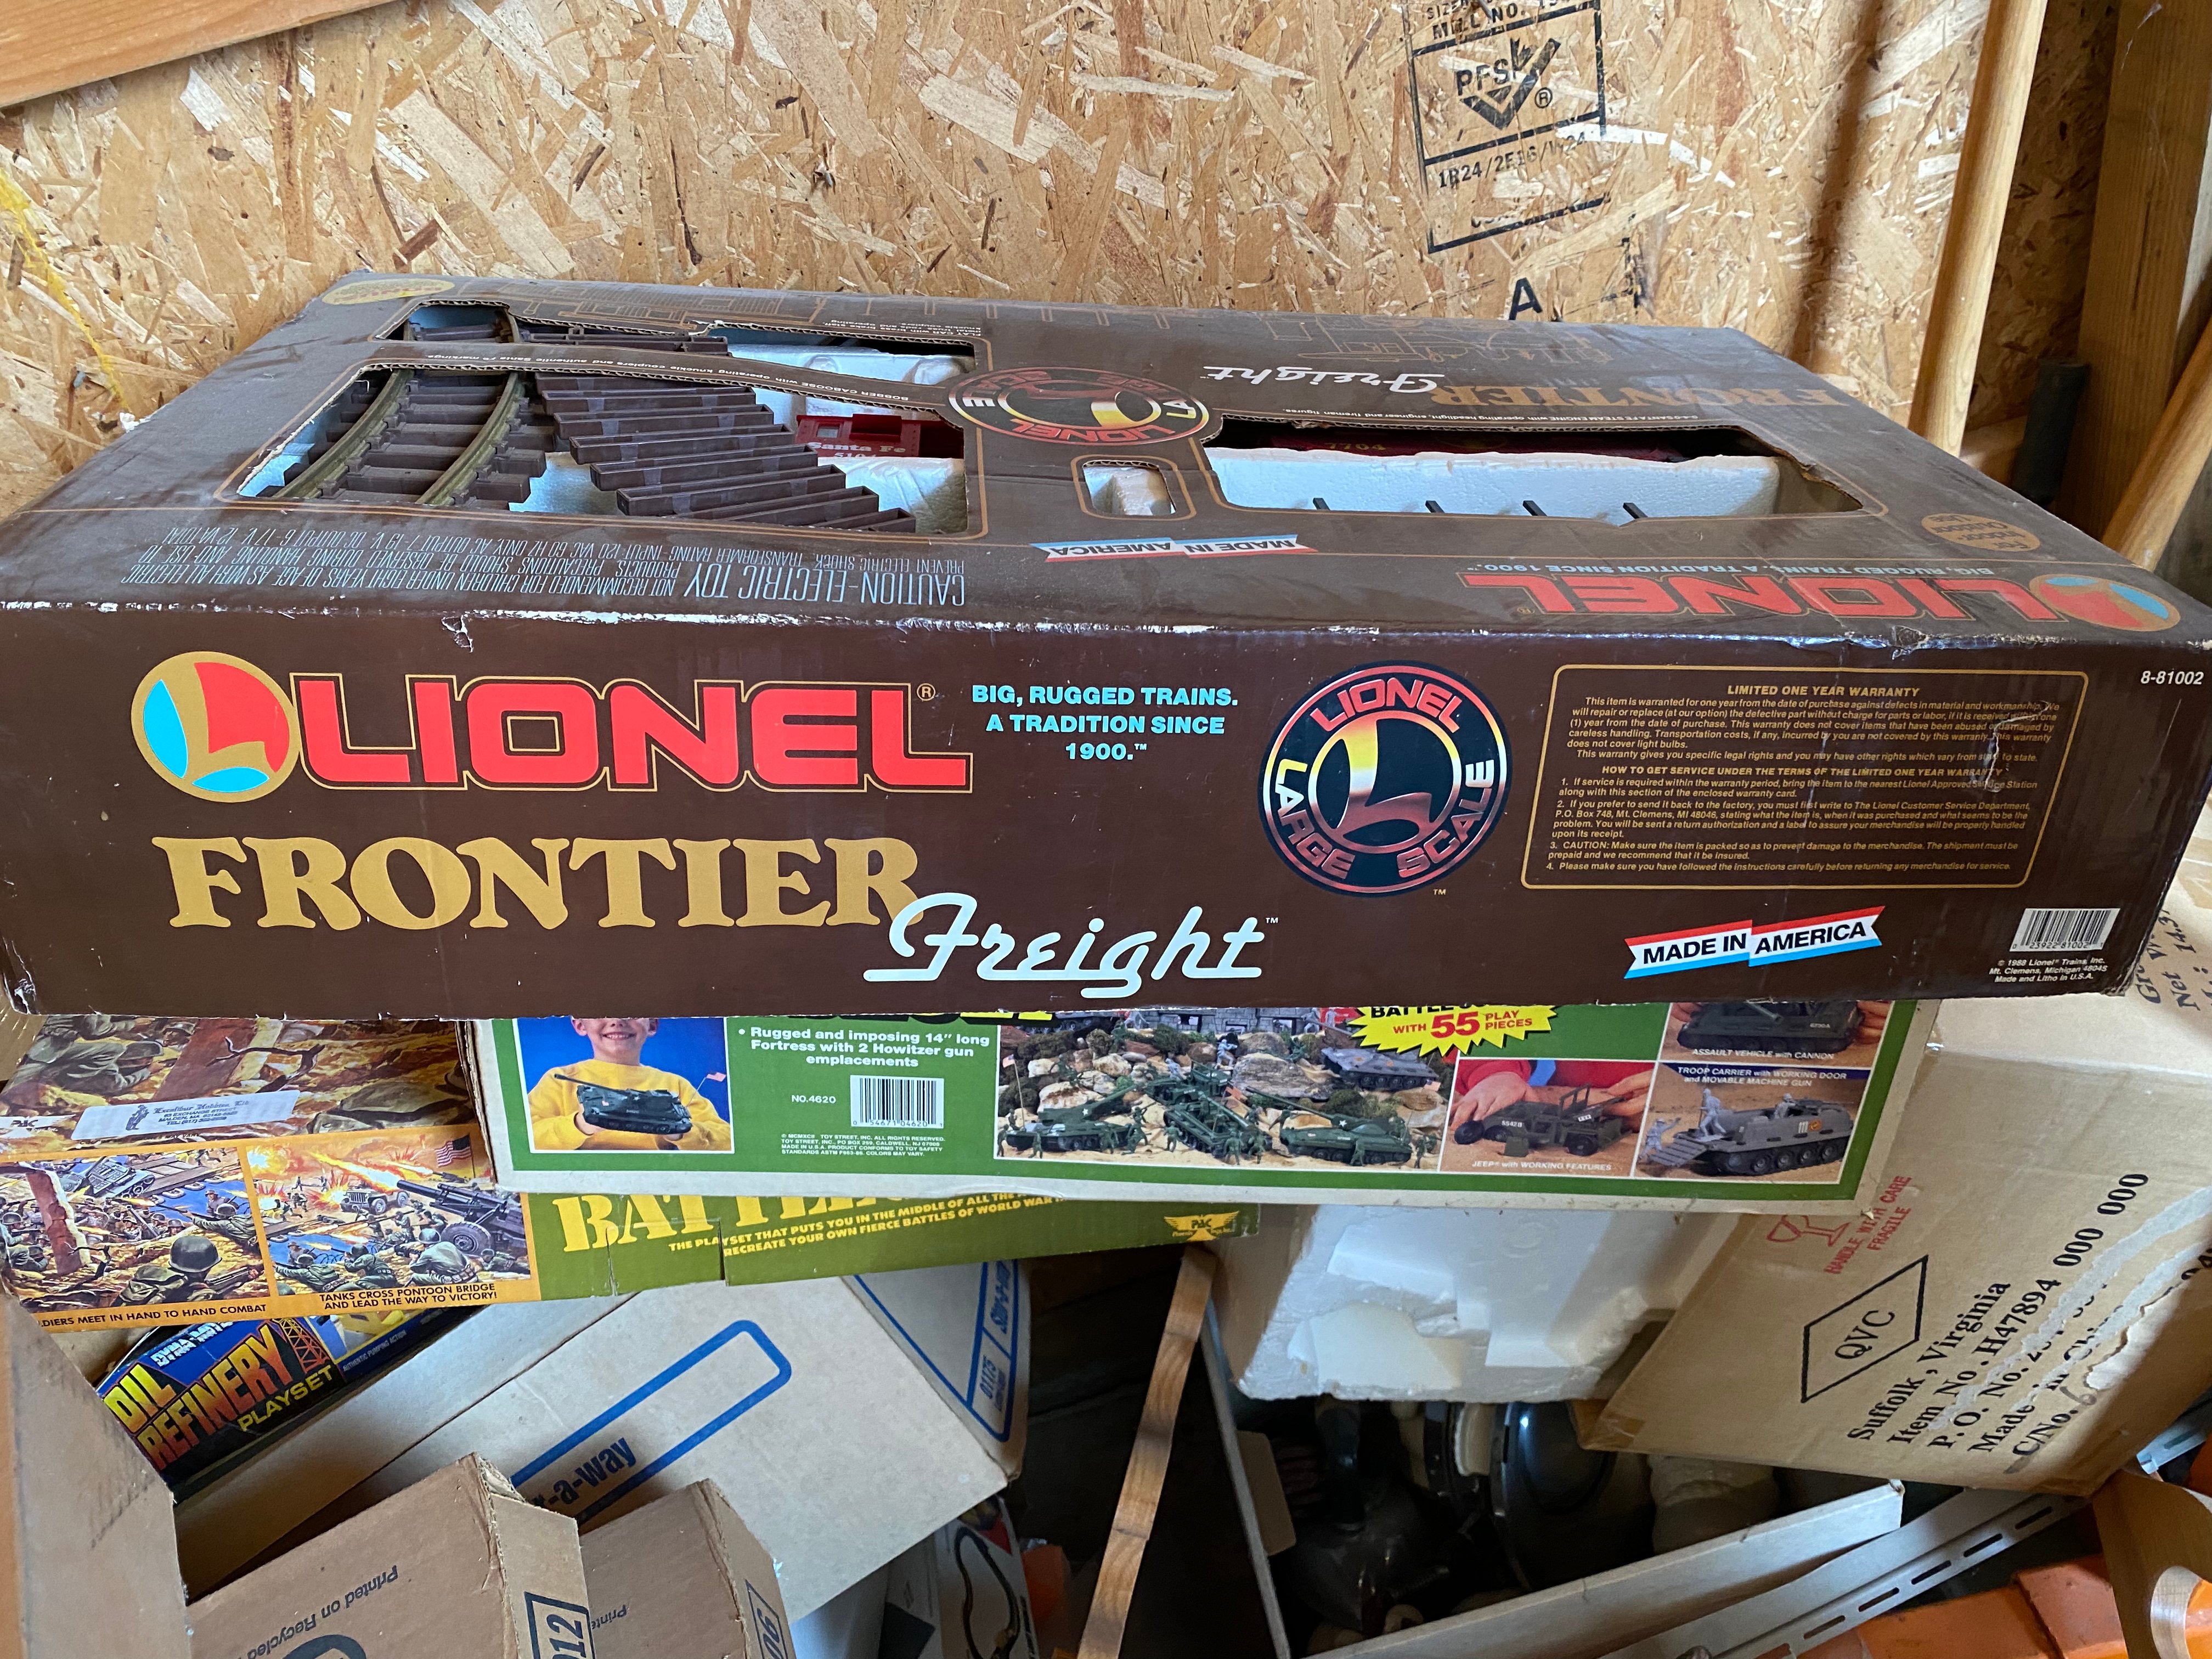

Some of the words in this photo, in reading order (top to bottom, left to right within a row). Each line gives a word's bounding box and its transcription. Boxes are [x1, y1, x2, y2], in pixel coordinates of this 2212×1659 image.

[1492, 3, 1526, 22] NO.
[719, 370, 770, 379] operating
[1202, 366, 1446, 394] Freight
[802, 382, 857, 393] CABOOSE
[861, 391, 909, 400] BOBBER
[1431, 385, 1835, 407] FRONTIER
[1009, 419, 1176, 441] LIONEL
[808, 442, 872, 451] Santa
[1050, 542, 1171, 555] AMERICA
[1188, 545, 1213, 553] IN
[1219, 540, 1296, 551] MADE
[1548, 565, 1614, 573] SINCE
[1618, 565, 1742, 573] TRADITION
[683, 562, 729, 599] TOY
[1462, 573, 2066, 620] LIONEL
[2140, 670, 2204, 685] 8-81002
[972, 685, 1023, 707] BIG,
[1029, 686, 1135, 706] RUGGED
[1141, 687, 1239, 707] TRAINS.
[1727, 686, 1778, 695] LIMITED
[1781, 686, 1808, 696] ONE
[1813, 686, 1844, 696] YEAR
[1849, 687, 1920, 697] WARRANTY
[1310, 676, 1464, 733] LIONEL
[1585, 697, 1605, 706] This
[1606, 697, 1628, 707] item
[1629, 698, 1637, 707] is
[1638, 698, 1684, 707] warranted
[1686, 698, 1698, 707] for
[1718, 701, 1740, 709] year
[1741, 699, 1760, 708] from
[1762, 699, 1776, 708] the
[1777, 699, 1796, 708] date
[289, 673, 974, 793] LIONEL
[986, 714, 1003, 732] A
[1009, 714, 1145, 733] TRADITION
[1150, 715, 1225, 735] SINCE
[1276, 758, 1355, 879] LARGE
[1397, 759, 1494, 878] SCALE
[151, 837, 924, 930] FRONTIER
[863, 893, 1265, 998] Freight
[1643, 939, 1717, 965] MADE
[1723, 932, 1747, 953] IN
[1754, 921, 1867, 955] AMERICA
[2162, 971, 2200, 1011] Net
[1393, 1023, 1426, 1034] WITH
[1430, 1011, 1480, 1039] 55
[1485, 1009, 1520, 1021] PLAY
[1485, 1018, 1532, 1030] PIECES
[751, 1027, 811, 1040] Rugged
[815, 1029, 844, 1040] and
[849, 1030, 919, 1043] imposing
[956, 1034, 990, 1047] long
[751, 1040, 816, 1051] Fortress
[820, 1042, 854, 1052] with
[859, 1043, 868, 1053] 2
[872, 1043, 941, 1055] Howitzer
[945, 1047, 974, 1058] gun
[806, 1056, 918, 1067] emplacements
[791, 1095, 836, 1104] NO.4620
[668, 1241, 692, 1251] THE
[695, 1235, 752, 1247] PLAYSET
[755, 1228, 787, 1240] THAT
[791, 1222, 823, 1234] PUTS
[826, 1217, 854, 1228] YOU
[856, 1215, 870, 1223] IN
[872, 1209, 895, 1221] THE
[898, 1203, 945, 1216] MIDDLE
[947, 1199, 963, 1208] OF
[966, 1194, 989, 1205] ALL
[723, 1239, 786, 1257] RECREATE
[788, 1233, 823, 1246] YOUR
[826, 1227, 857, 1239] OWN
[859, 1220, 900, 1234] FIERCE
[902, 1210, 955, 1227] BATTLES
[958, 1208, 974, 1217] OF
[977, 1200, 1022, 1214] WORLD
[1824, 1238, 1864, 1274] HANDLE
[1879, 1176, 1912, 1203] CARE
[1866, 1207, 1912, 1250] FRAGILE
[319, 1293, 355, 1302] TANKS
[359, 1290, 394, 1299] CROSS
[397, 1286, 452, 1296] PONTOON
[456, 1284, 495, 1293] BRIDGE
[352, 1299, 379, 1307] LEAD
[382, 1297, 402, 1306] THE
[404, 1295, 428, 1304] WAY
[431, 1294, 445, 1302] TO
[450, 1291, 497, 1301] VICTORY!
[78, 1315, 106, 1324] MEET
[126, 1312, 161, 1321] HAND
[163, 1310, 178, 1318] TO
[182, 1308, 217, 1317] HAND
[219, 1305, 267, 1314] COMBAT
[1887, 1407, 1943, 1446] Item
[1976, 1278, 2061, 1358] H47894
[2053, 1228, 2104, 1267] 000
[2097, 1173, 2149, 1216] 000
[1834, 1308, 1896, 1361] QVC
[342, 1353, 368, 1372] AUTHENTIC
[390, 1329, 407, 1346] ACTION
[1848, 1378, 1923, 1441] Suffolk
[1917, 1281, 2011, 1367] Virginia
[103, 1363, 176, 1432] OIL
[137, 1324, 295, 1471] REFINERY
[239, 1364, 333, 1431] PLAYSET
[344, 1564, 398, 1601] Printed
[321, 1599, 341, 1622] on
[246, 1613, 317, 1659] Recycled
